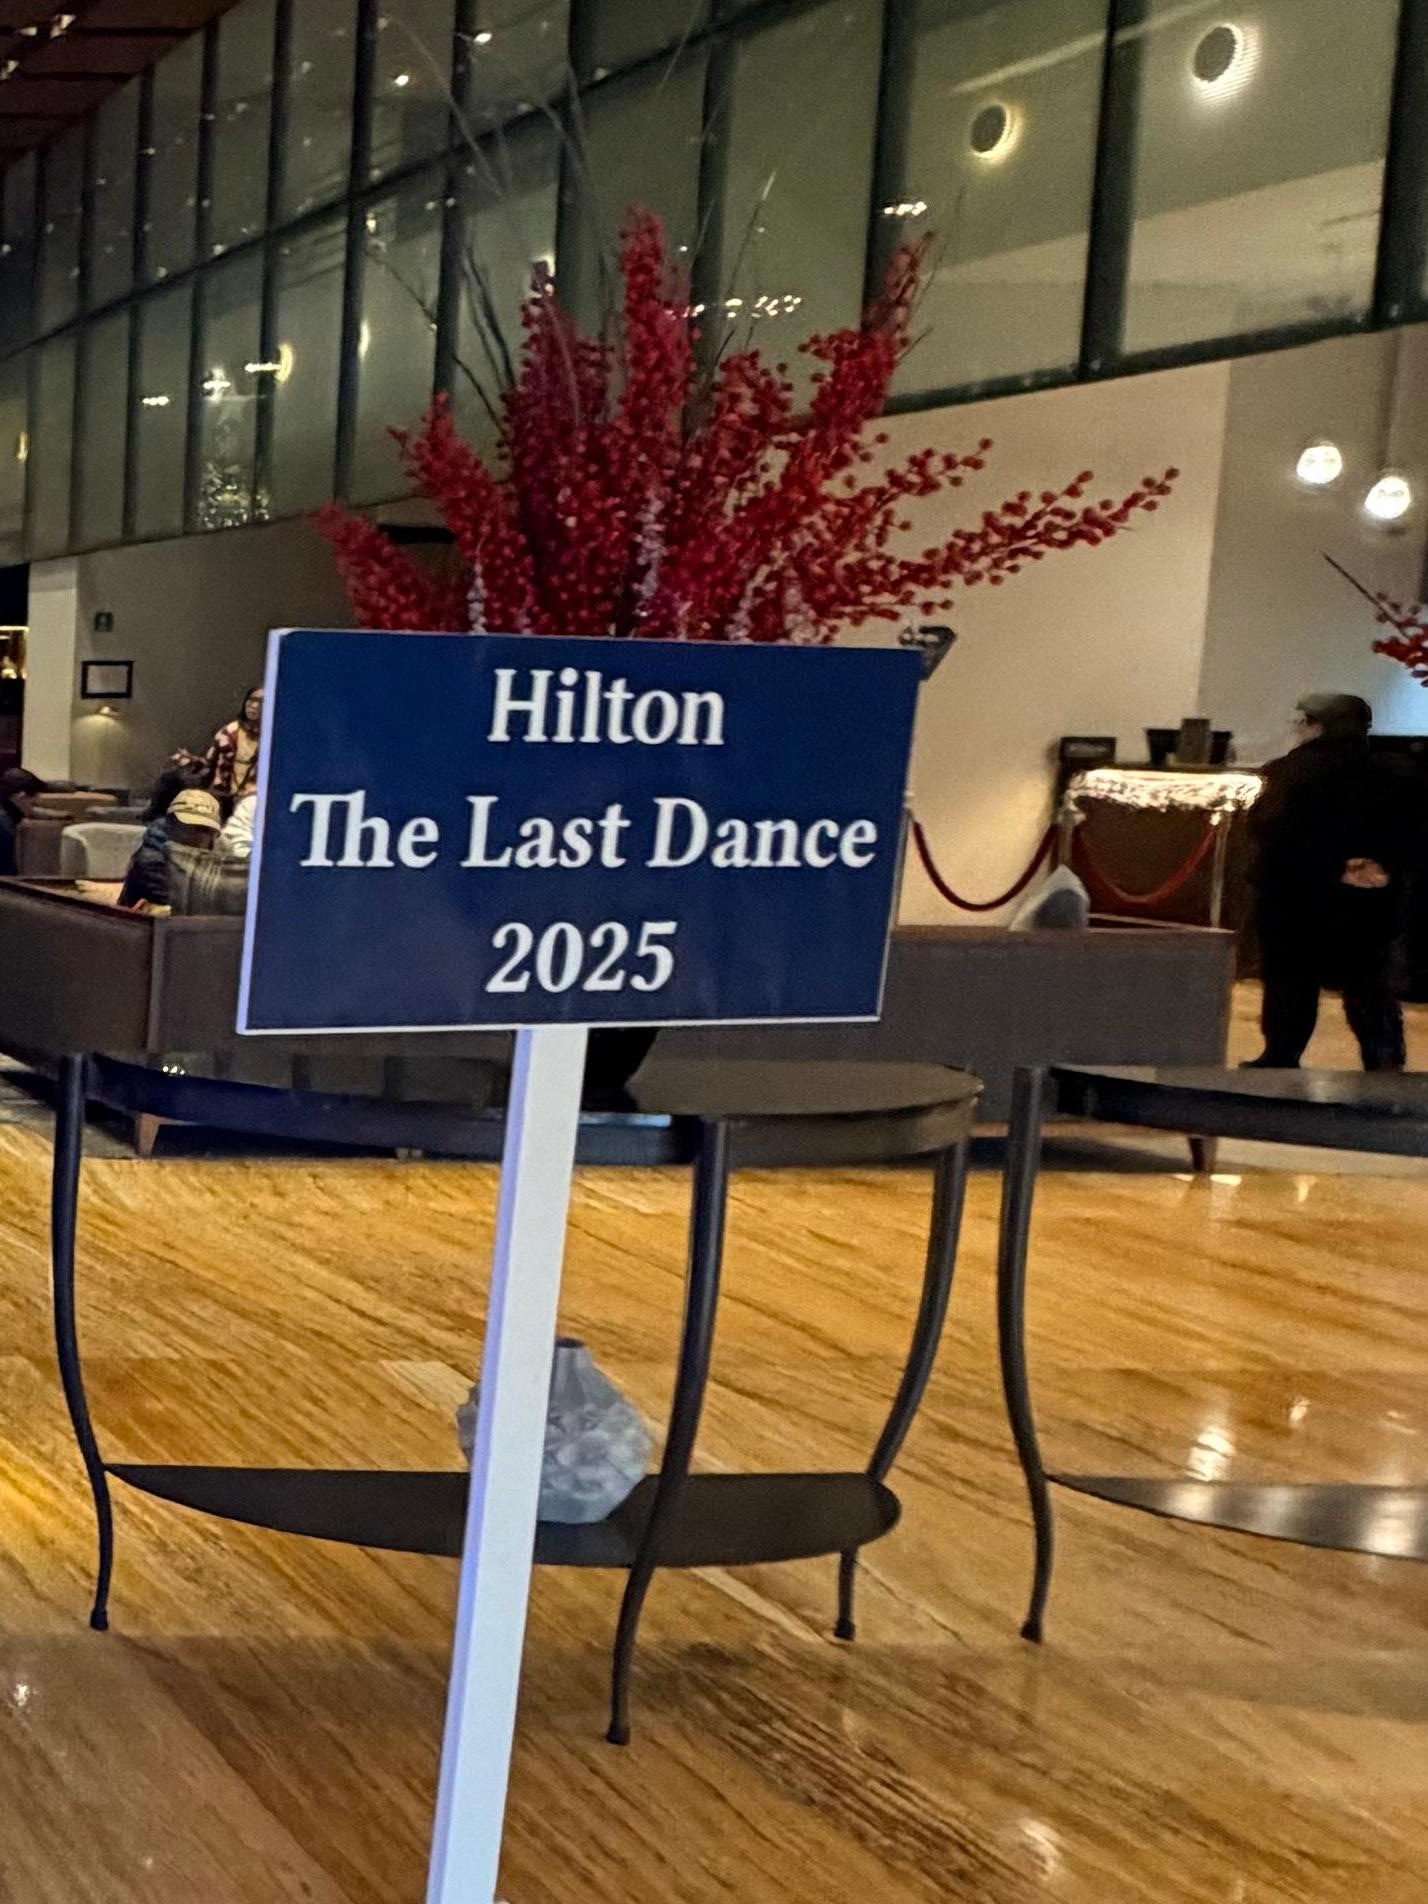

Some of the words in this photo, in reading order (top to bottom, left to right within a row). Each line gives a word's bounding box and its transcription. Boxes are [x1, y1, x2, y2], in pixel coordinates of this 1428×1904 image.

[487, 667, 725, 746] Hilton
[289, 790, 441, 869] The
[460, 796, 631, 870] Last
[646, 797, 878, 869] Dance
[486, 921, 679, 994] 2025
